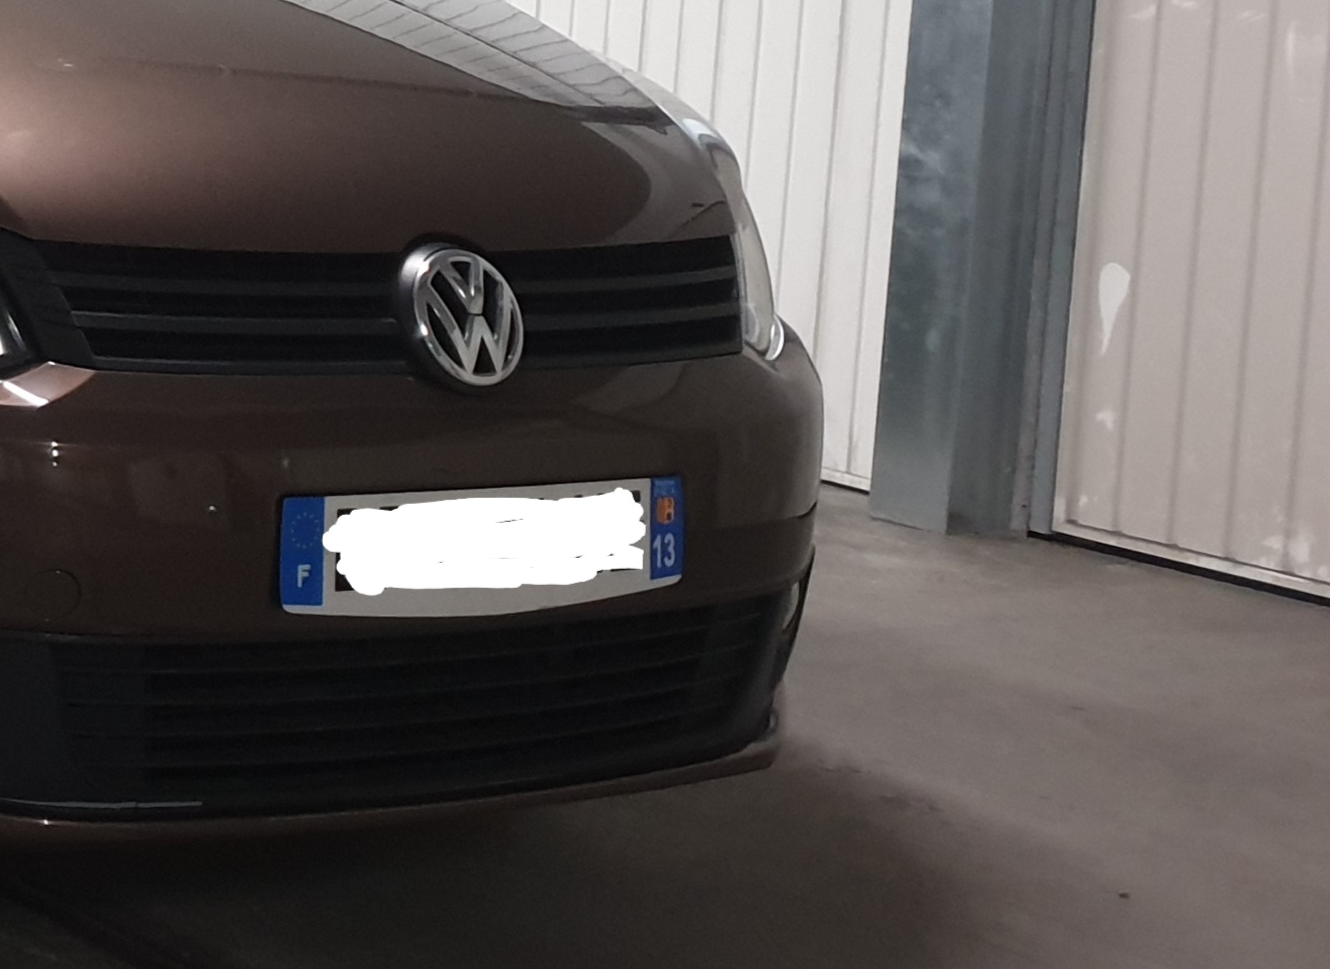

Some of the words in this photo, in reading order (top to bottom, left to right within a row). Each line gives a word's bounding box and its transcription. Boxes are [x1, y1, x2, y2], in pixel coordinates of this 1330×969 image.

[416, 251, 522, 384] VW
[653, 533, 676, 568] 13
[297, 564, 311, 588] F
